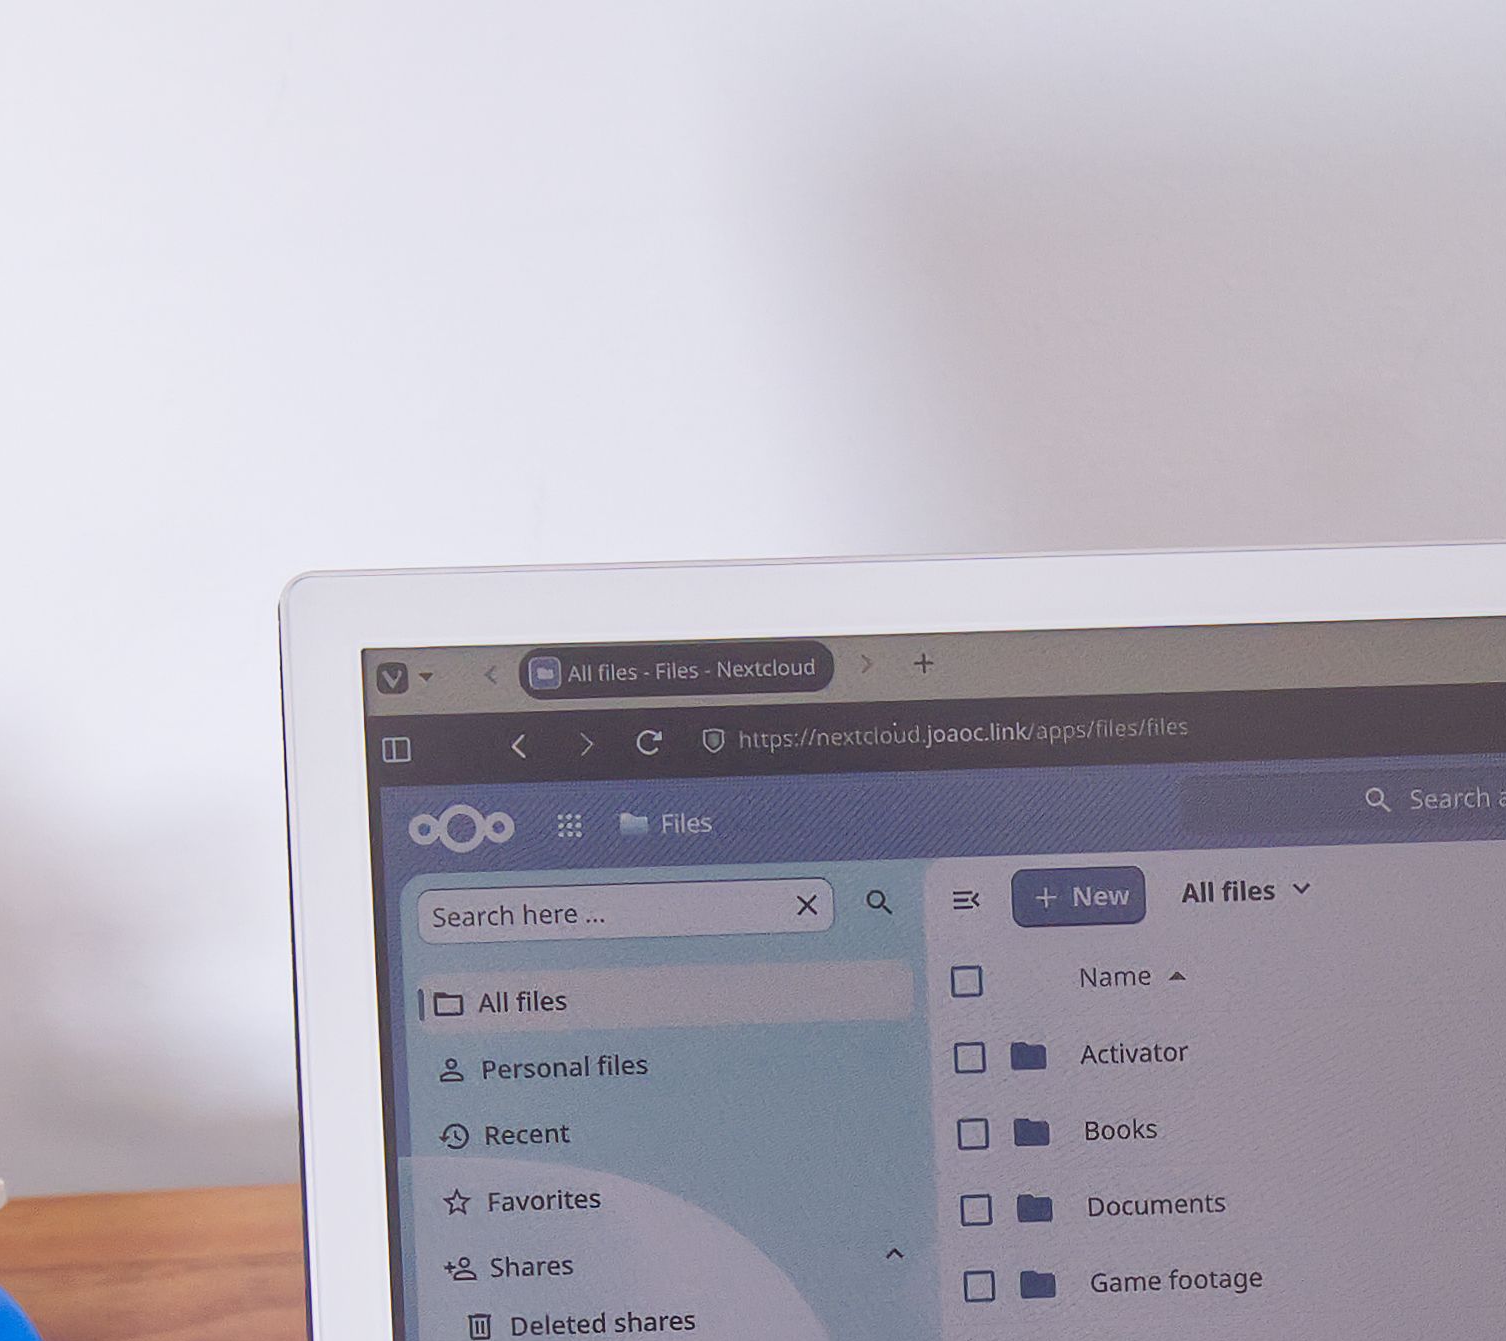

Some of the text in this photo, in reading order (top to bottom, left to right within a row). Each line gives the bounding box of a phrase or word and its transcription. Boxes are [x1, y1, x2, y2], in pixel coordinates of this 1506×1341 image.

[567, 657, 816, 683] All files Files Nextcloud
[1410, 786, 1490, 810] Search
[661, 812, 713, 834] Files
[1073, 886, 1130, 907] New
[1181, 880, 1276, 904] All files
[432, 903, 578, 928] Search here
[1080, 967, 1152, 988] Name
[478, 990, 568, 1013] All files
[1080, 1042, 1189, 1065] Activator
[482, 1054, 649, 1080] Personal files
[485, 1124, 571, 1146] Recent
[1085, 1118, 1158, 1141] Books
[488, 1189, 602, 1212] Favorites
[1087, 1194, 1226, 1218] Documents
[490, 1256, 574, 1279] Shares
[1090, 1268, 1263, 1295] Game footage
[511, 1311, 696, 1337] Deleted shares
